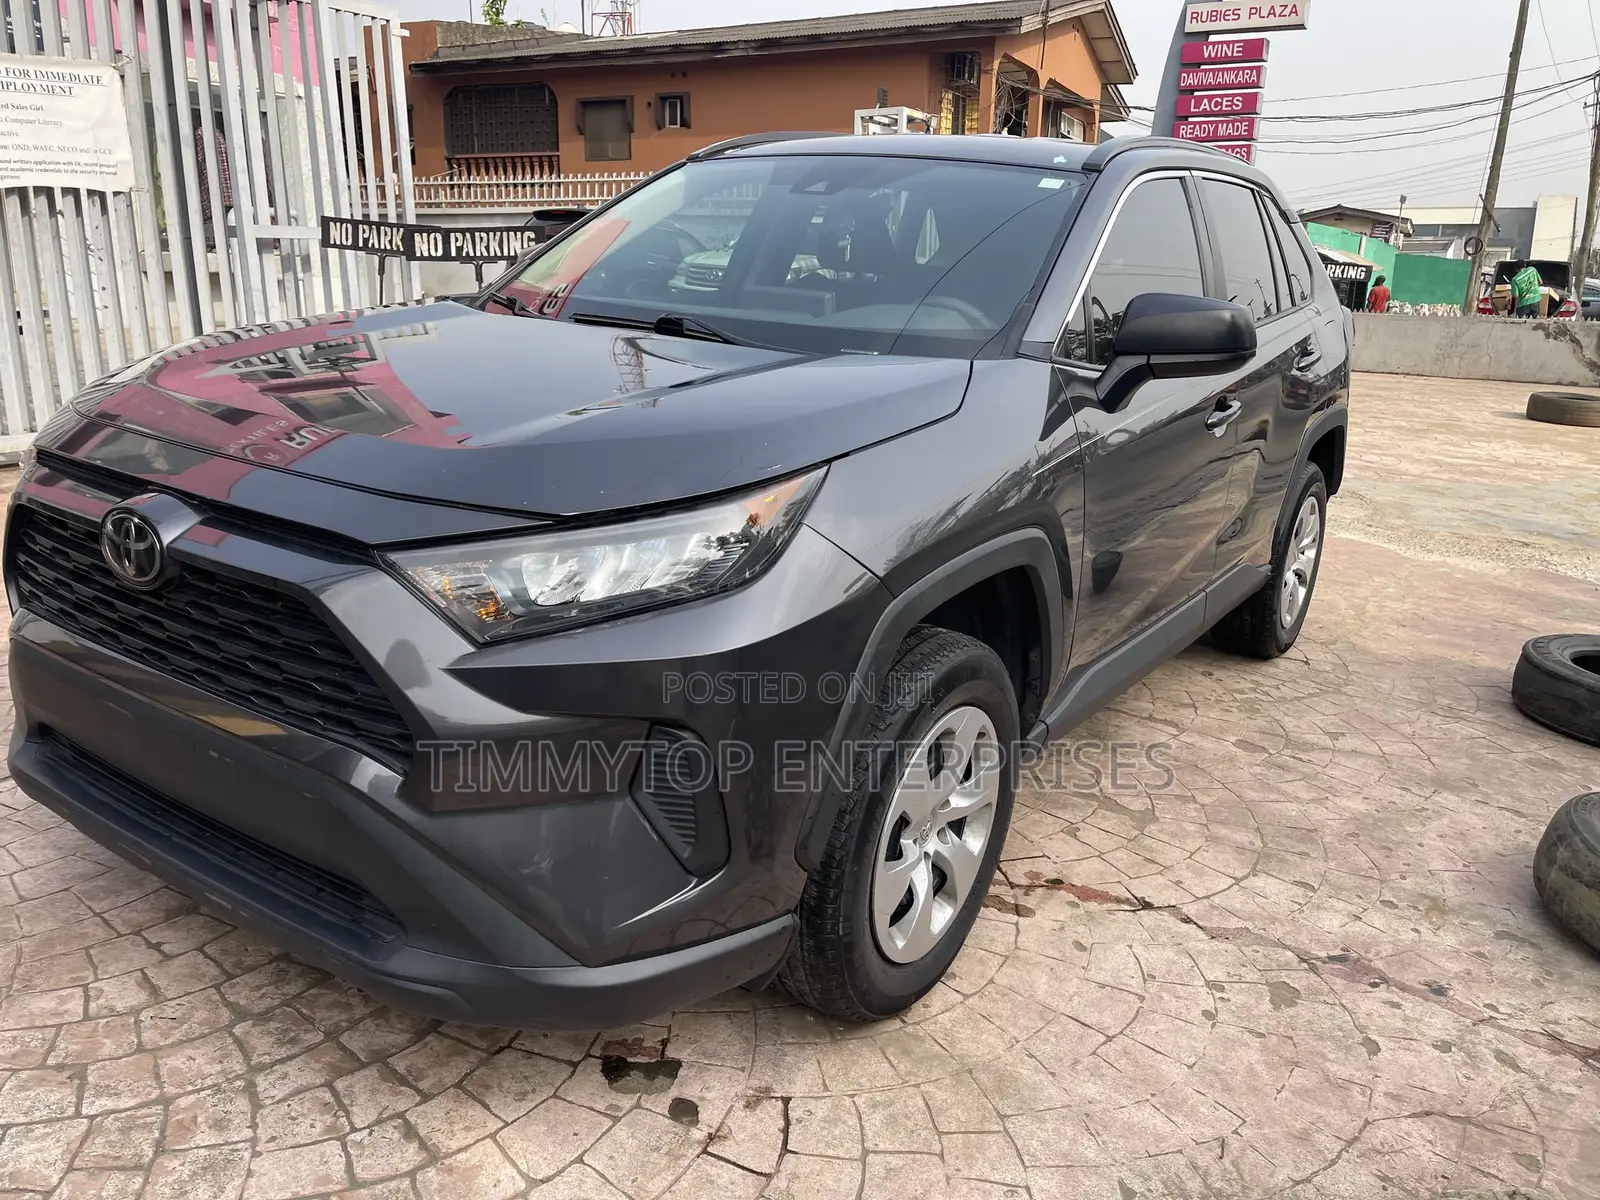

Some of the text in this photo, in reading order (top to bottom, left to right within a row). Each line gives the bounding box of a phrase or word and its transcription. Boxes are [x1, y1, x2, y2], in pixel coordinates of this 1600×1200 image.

[1190, 3, 1299, 24] RUBIES PLAZA
[1203, 42, 1244, 58] WINE
[4, 66, 103, 84] FOR IMMEDIATE
[1180, 69, 1258, 86] DAVIVA/ANKARA
[1190, 96, 1243, 112] LACES
[4, 116, 63, 127] Computer Literacy
[1179, 121, 1249, 138] READY MADE
[329, 221, 352, 246] NO
[414, 231, 536, 257] NO PARKING
